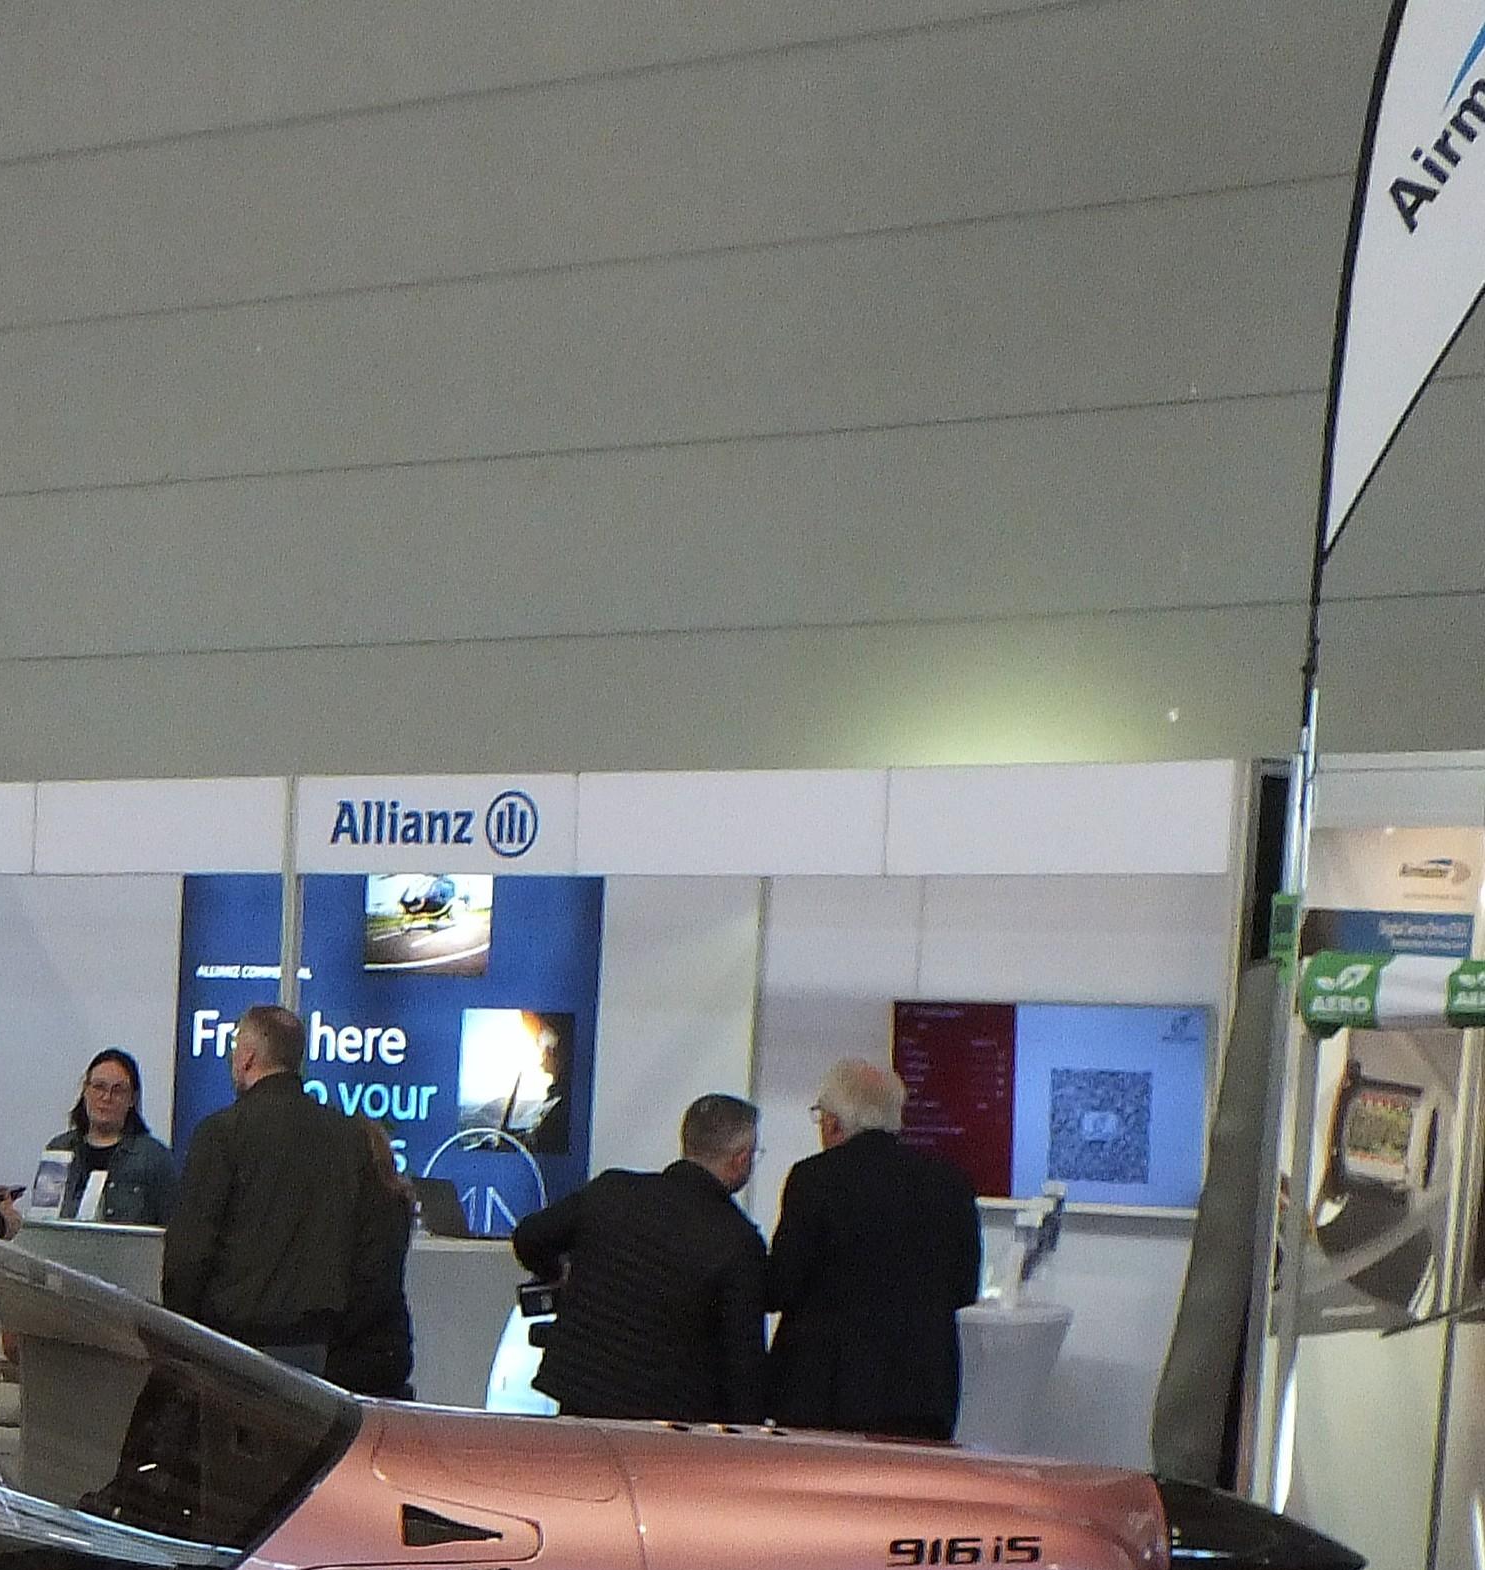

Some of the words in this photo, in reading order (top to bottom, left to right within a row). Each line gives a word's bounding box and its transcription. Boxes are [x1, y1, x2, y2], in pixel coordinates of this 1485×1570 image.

[1388, 78, 1485, 233] Airm
[331, 799, 475, 845] Allianz
[309, 1011, 407, 1064] here
[887, 1538, 983, 1568] 916
